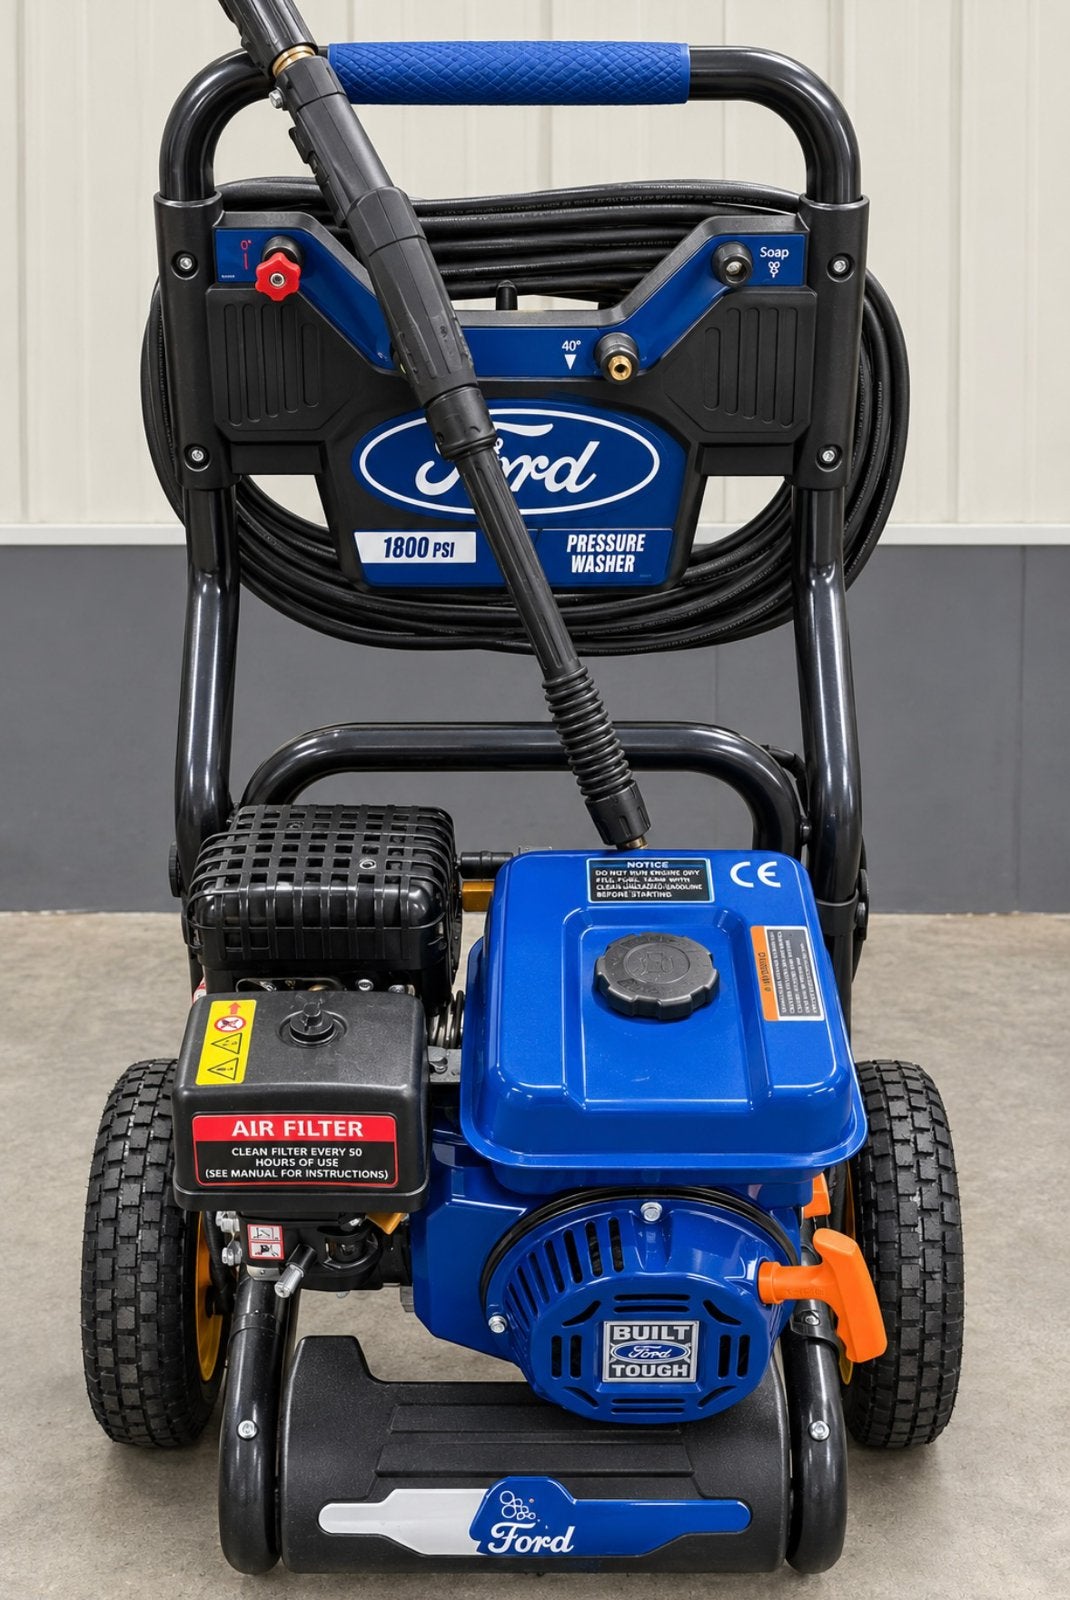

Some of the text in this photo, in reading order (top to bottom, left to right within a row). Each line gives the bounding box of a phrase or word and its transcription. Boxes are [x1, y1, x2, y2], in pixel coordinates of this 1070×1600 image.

[760, 246, 789, 260] Soap
[561, 340, 581, 352] 40°
[383, 536, 455, 559] 1800 PSI
[566, 533, 646, 553] PRESSURE
[571, 554, 635, 573] WASHER
[627, 861, 669, 869] NOTICE
[232, 1120, 364, 1138] AIR FILTER
[231, 1147, 268, 1157] CLEAN
[271, 1147, 308, 1157] FILTER
[311, 1147, 346, 1157] EVERY
[255, 1158, 339, 1168] HOURS OF USE
[205, 1169, 389, 1180] (SEE MANUAL FOR INSTRUCTIONS)
[613, 1325, 690, 1340] BUILT
[628, 1345, 673, 1359] Ford
[611, 1364, 688, 1377] TOUGH
[487, 1521, 576, 1554] Ford
